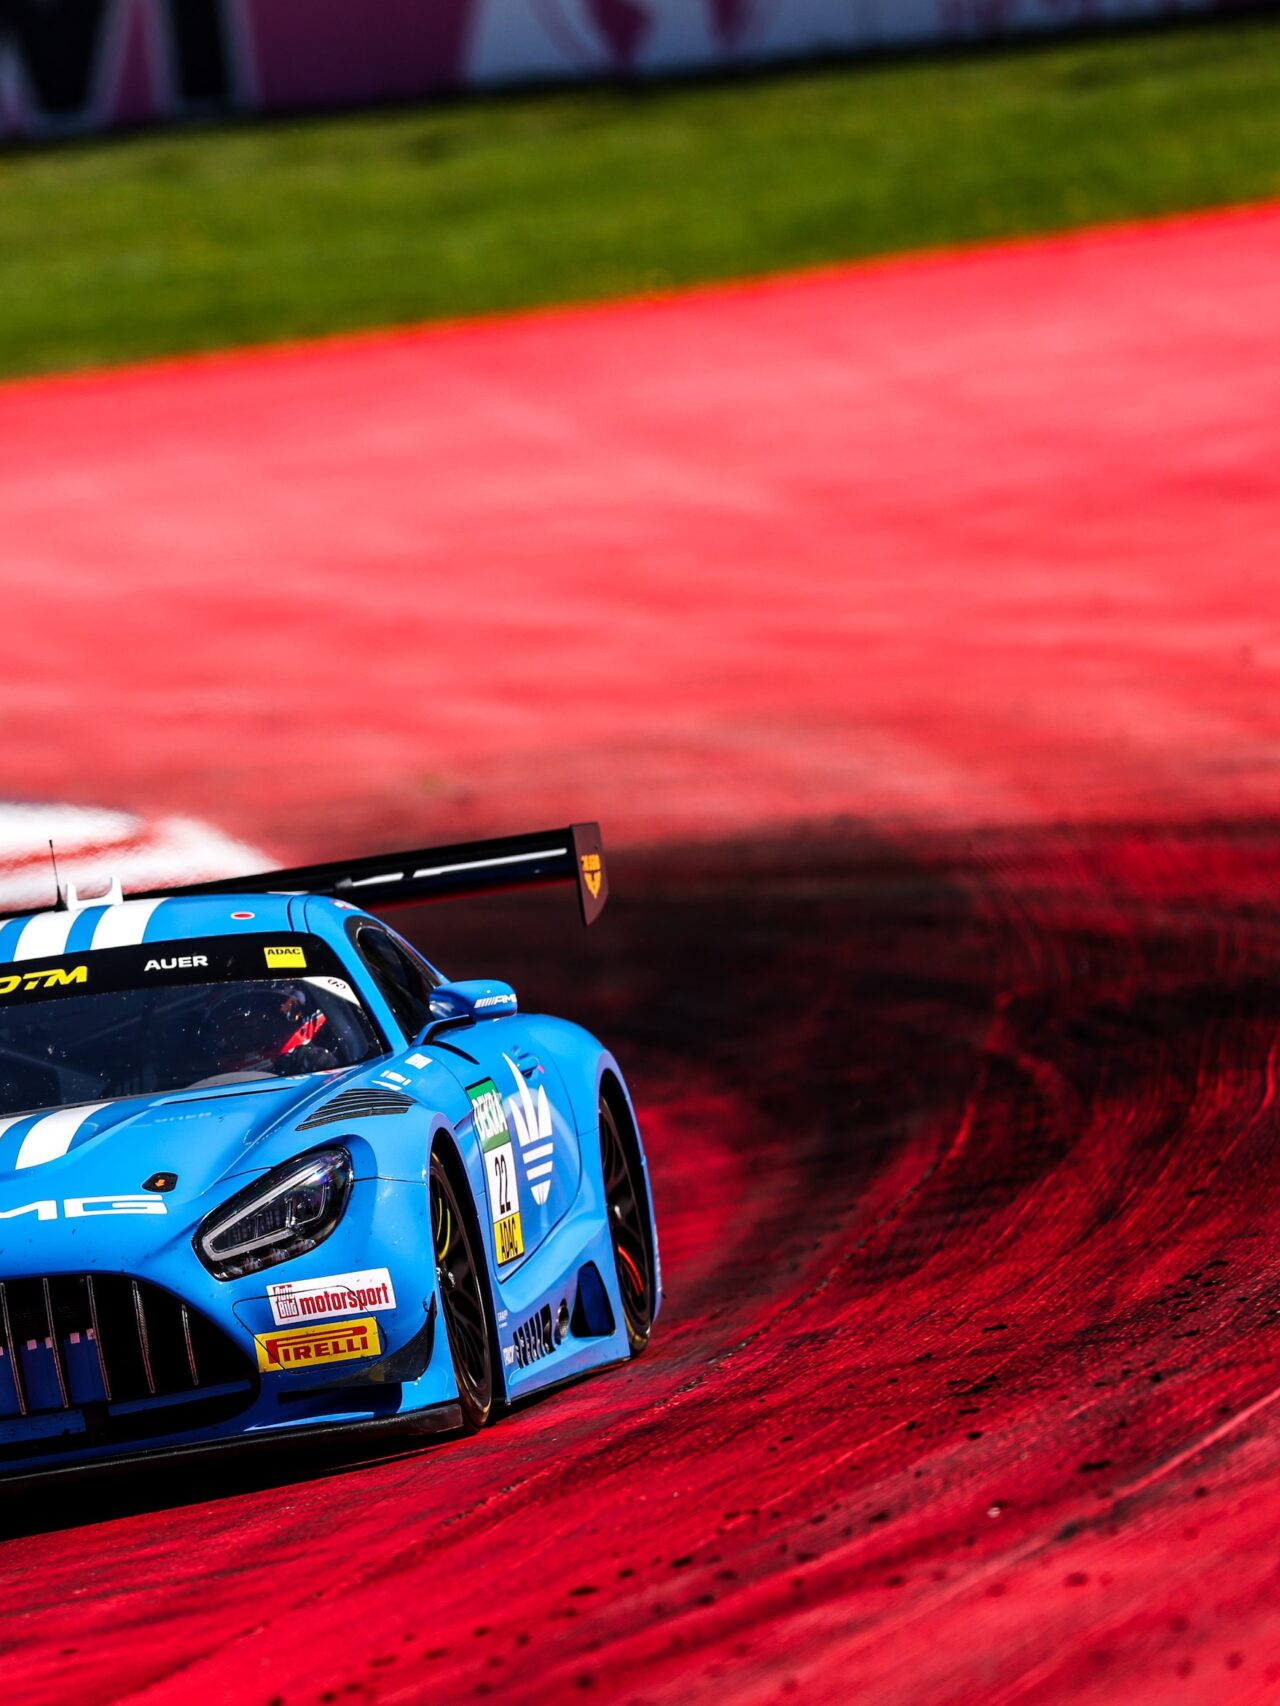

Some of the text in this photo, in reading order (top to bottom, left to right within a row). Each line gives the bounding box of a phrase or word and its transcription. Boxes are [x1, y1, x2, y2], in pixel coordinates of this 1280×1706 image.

[143, 954, 209, 972] AUER
[267, 948, 301, 956] ADAC
[471, 1089, 509, 1140] DEKRA
[494, 1153, 512, 1215] 22
[499, 1217, 519, 1261] ADAC
[299, 1282, 390, 1315] motorsport
[265, 1325, 369, 1364] PIRELLI
